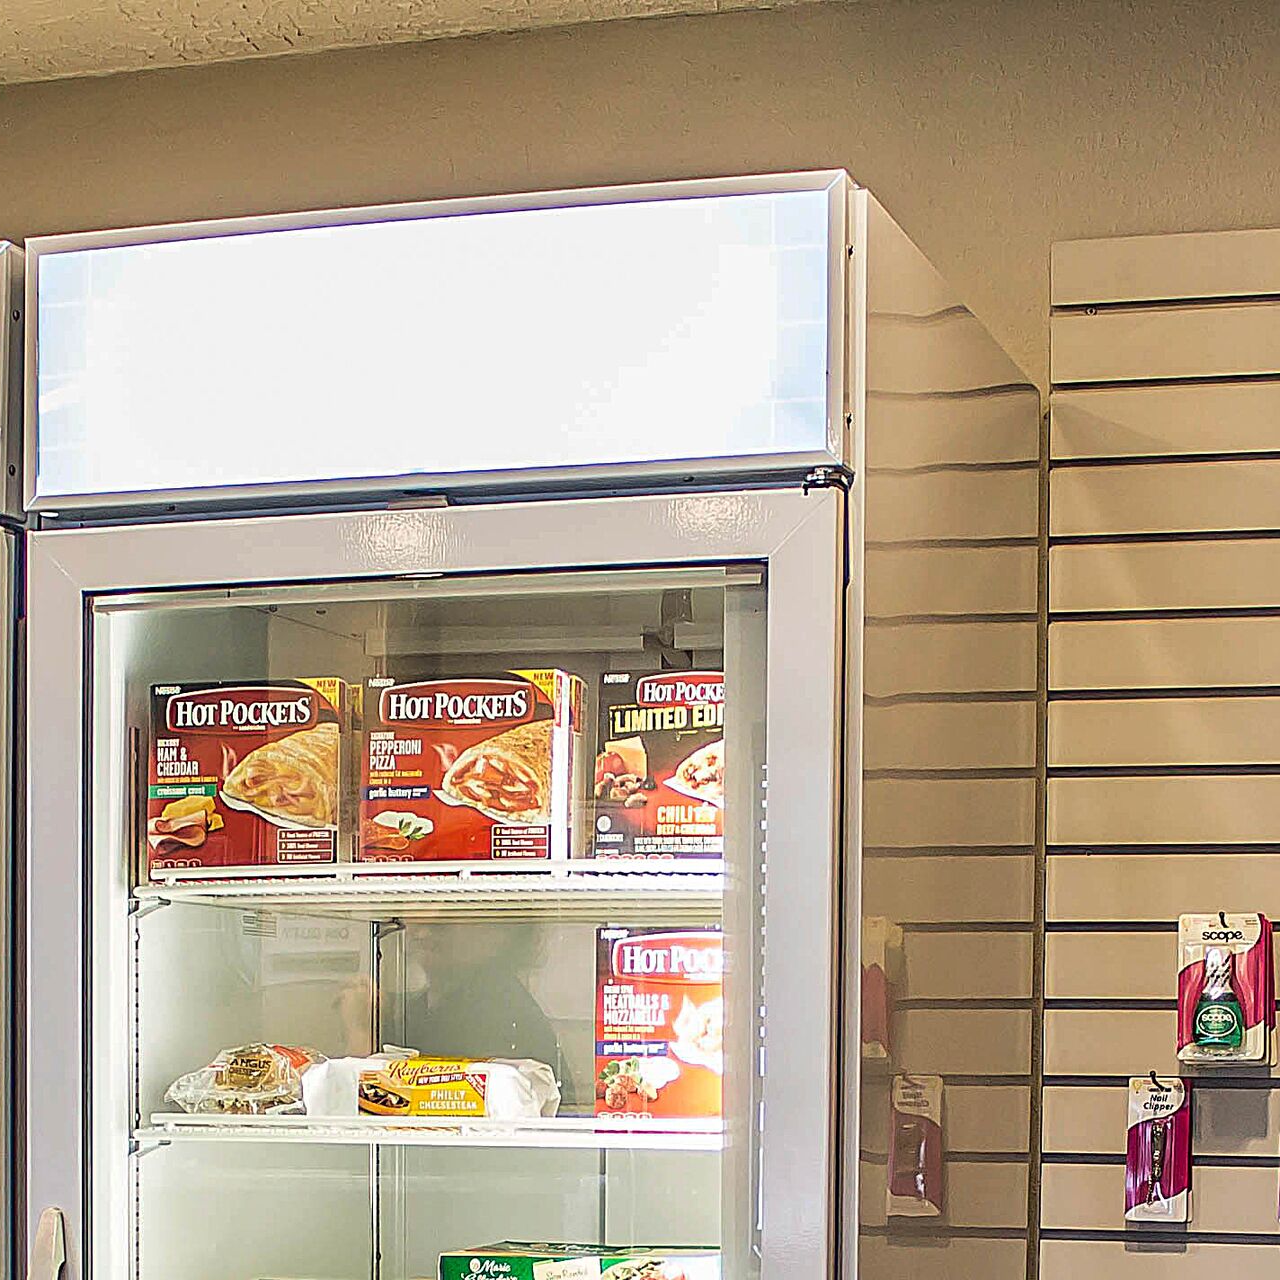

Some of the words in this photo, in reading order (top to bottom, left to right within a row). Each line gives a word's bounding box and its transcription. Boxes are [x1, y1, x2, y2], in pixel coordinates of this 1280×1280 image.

[317, 680, 337, 688] NEW
[676, 682, 724, 702] POCKE
[220, 697, 311, 726] POCKETS
[434, 690, 527, 719] POCKETS
[615, 706, 687, 734] LIMITED
[157, 747, 178, 762] HAM
[180, 747, 187, 762] &
[370, 740, 422, 755] PEPPERONI
[157, 762, 199, 776] CHEDDAR
[370, 756, 396, 769] PIZZA
[1202, 930, 1243, 943] scope
[430, 1090, 465, 1100] PHILLY
[1150, 1094, 1168, 1102] Nail
[1143, 1102, 1174, 1112] Clipper
[479, 1259, 511, 1275] Marie
